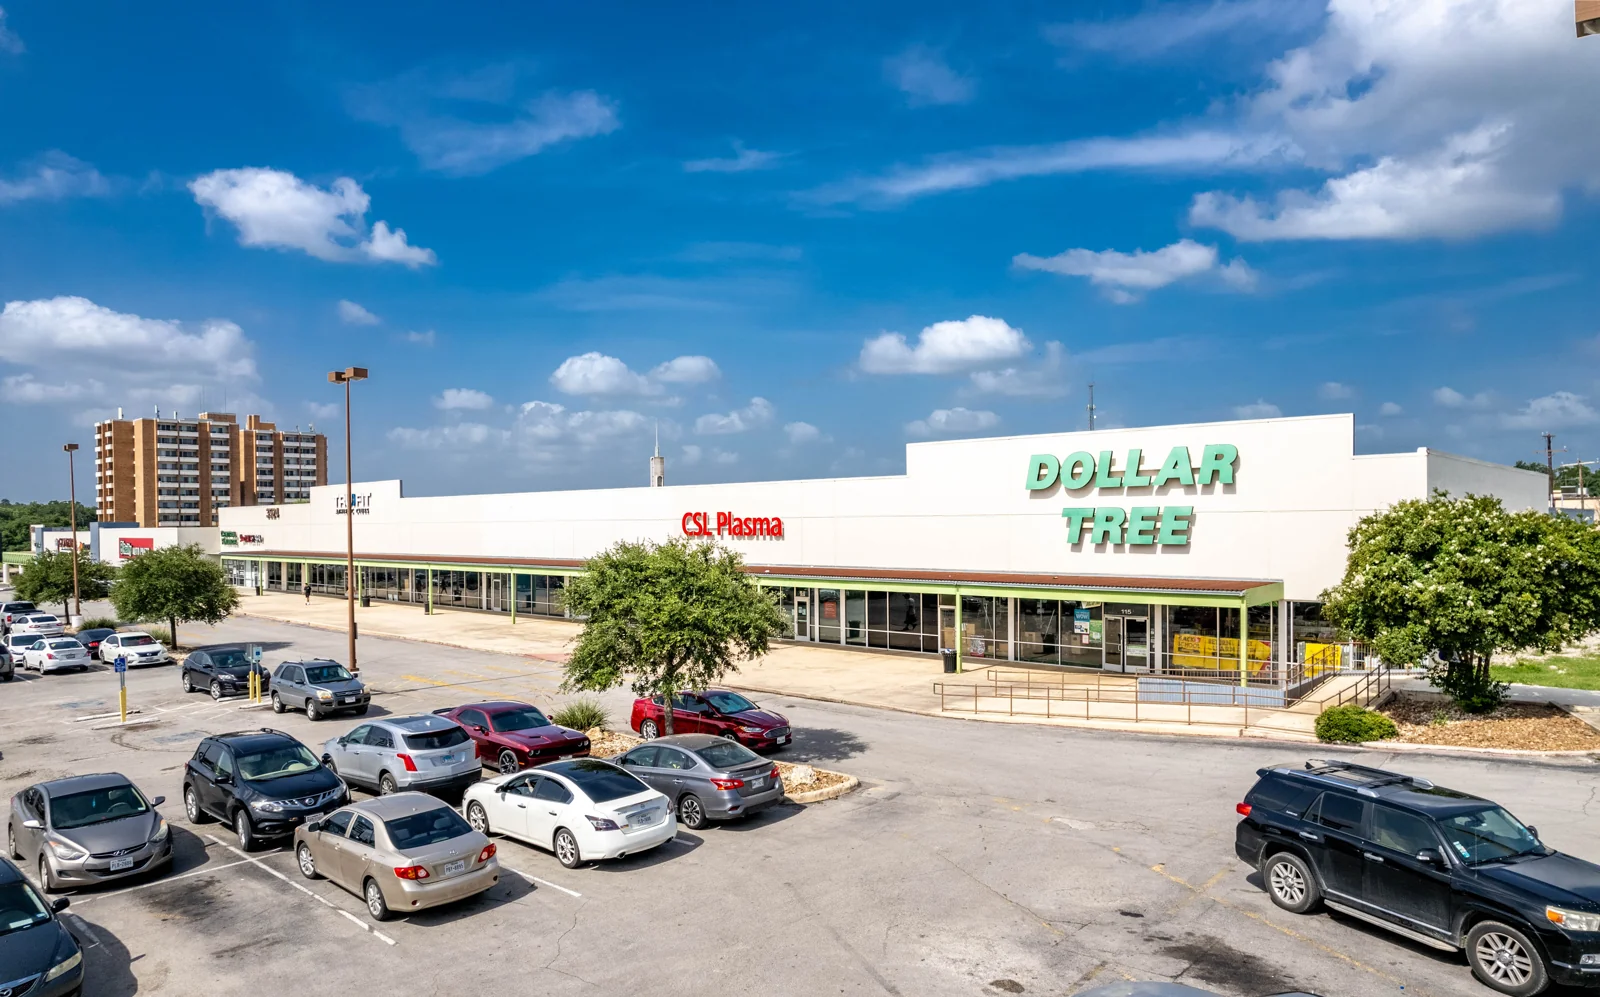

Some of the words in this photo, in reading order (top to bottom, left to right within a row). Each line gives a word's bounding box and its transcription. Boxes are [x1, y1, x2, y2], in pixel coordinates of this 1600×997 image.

[1025, 443, 1239, 490] DOLLAR
[682, 511, 713, 536] CSL
[717, 511, 783, 536] Plasma
[1061, 505, 1194, 545] TREE
